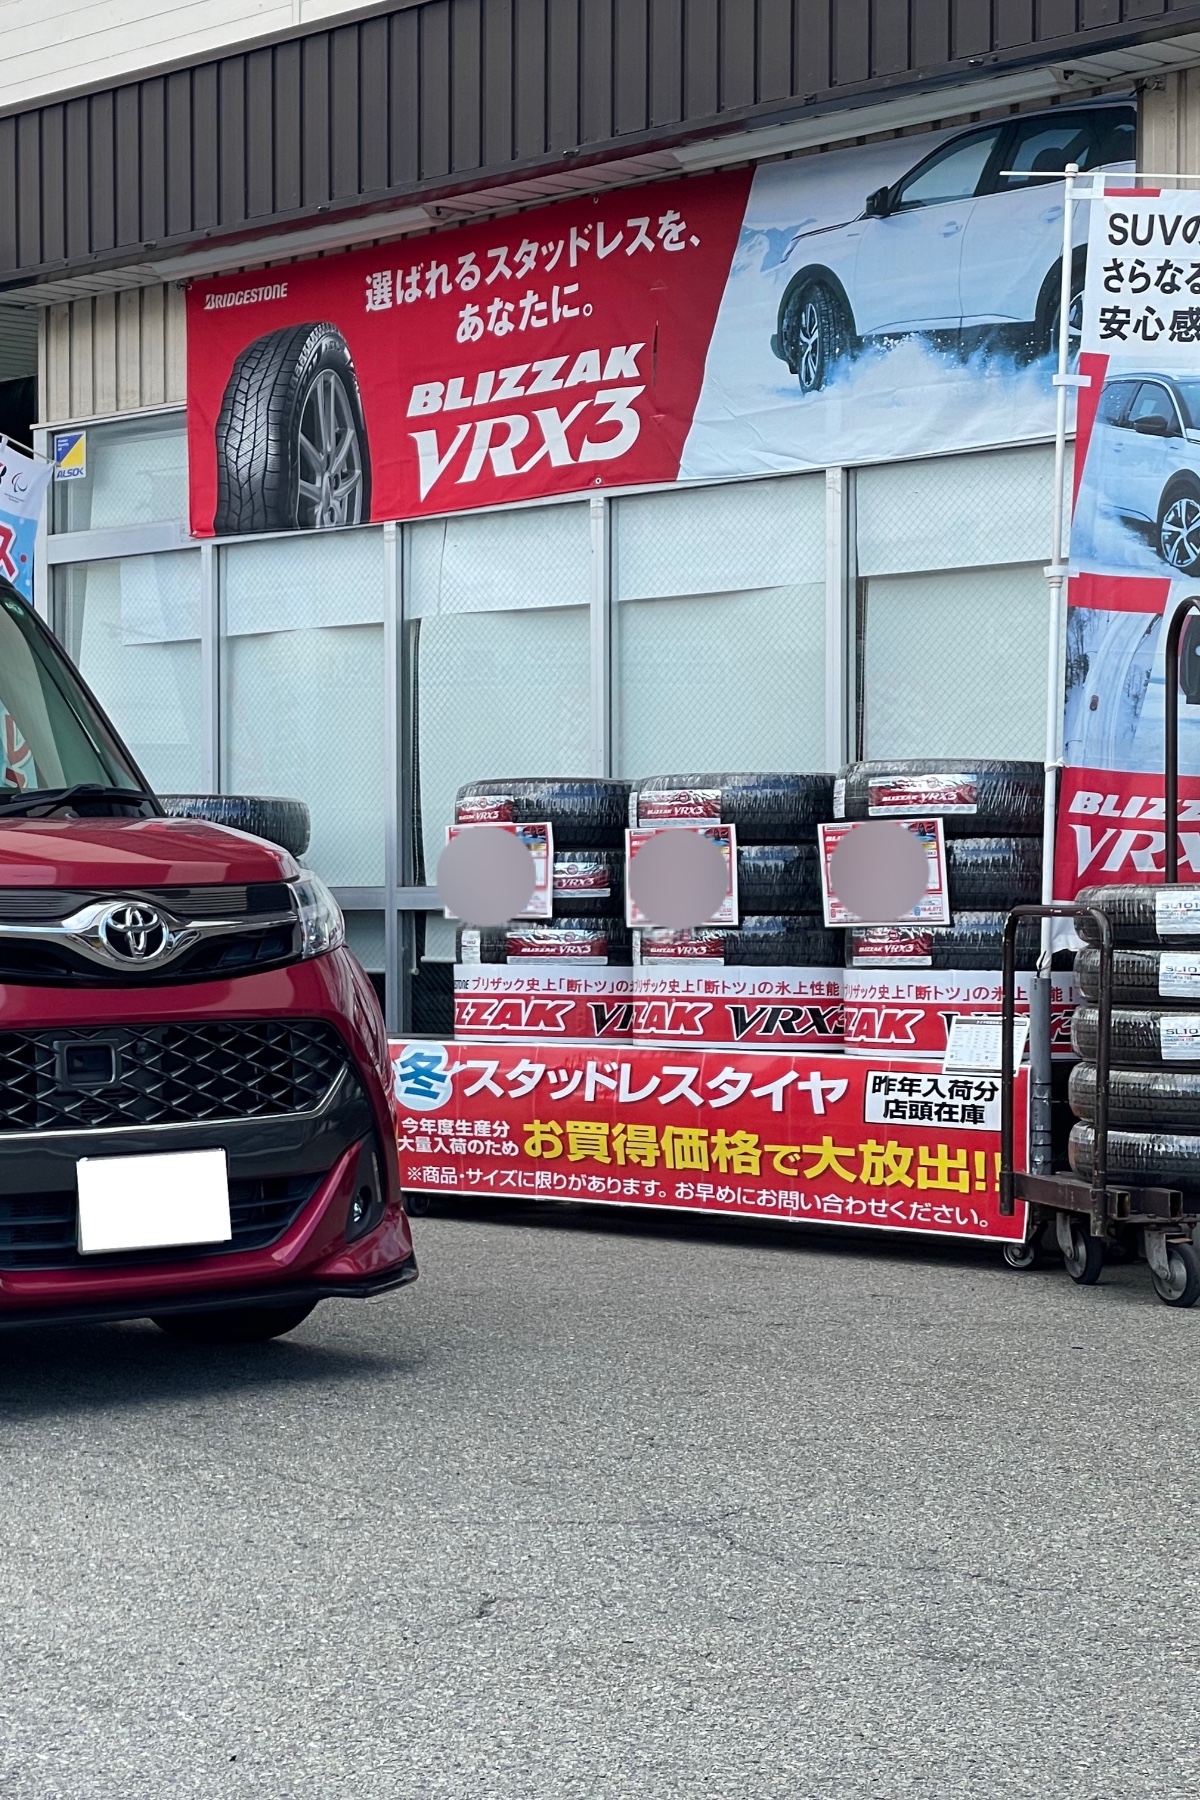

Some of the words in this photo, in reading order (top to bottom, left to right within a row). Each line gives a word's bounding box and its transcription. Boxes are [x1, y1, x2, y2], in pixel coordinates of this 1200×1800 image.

[365, 209, 700, 314] 選ばれるスタッドレスを、
[204, 282, 288, 310] BRIDGESTONE
[456, 283, 594, 344] あなたに。
[1099, 305, 1200, 343] 安心感
[406, 342, 646, 418] BLIZZAK
[407, 384, 646, 503] VRX3
[56, 467, 84, 479] ALSOK
[919, 791, 958, 802] VRX3
[476, 810, 500, 821] VRX3
[673, 805, 705, 816] VRX3
[561, 877, 595, 888] VRX3
[558, 944, 592, 954] VRX3
[676, 945, 707, 955] VRX3
[884, 944, 914, 954] VRX3
[1165, 965, 1200, 973] SL10
[400, 1052, 448, 1100] 冬
[463, 1057, 849, 1116] スタッドレスタイヤ
[872, 1075, 999, 1102] 昨年入荷分
[883, 1099, 986, 1125] 店頭在庫
[401, 1117, 510, 1138] 今年度生産分
[398, 1136, 519, 1156] 大量入荷のため
